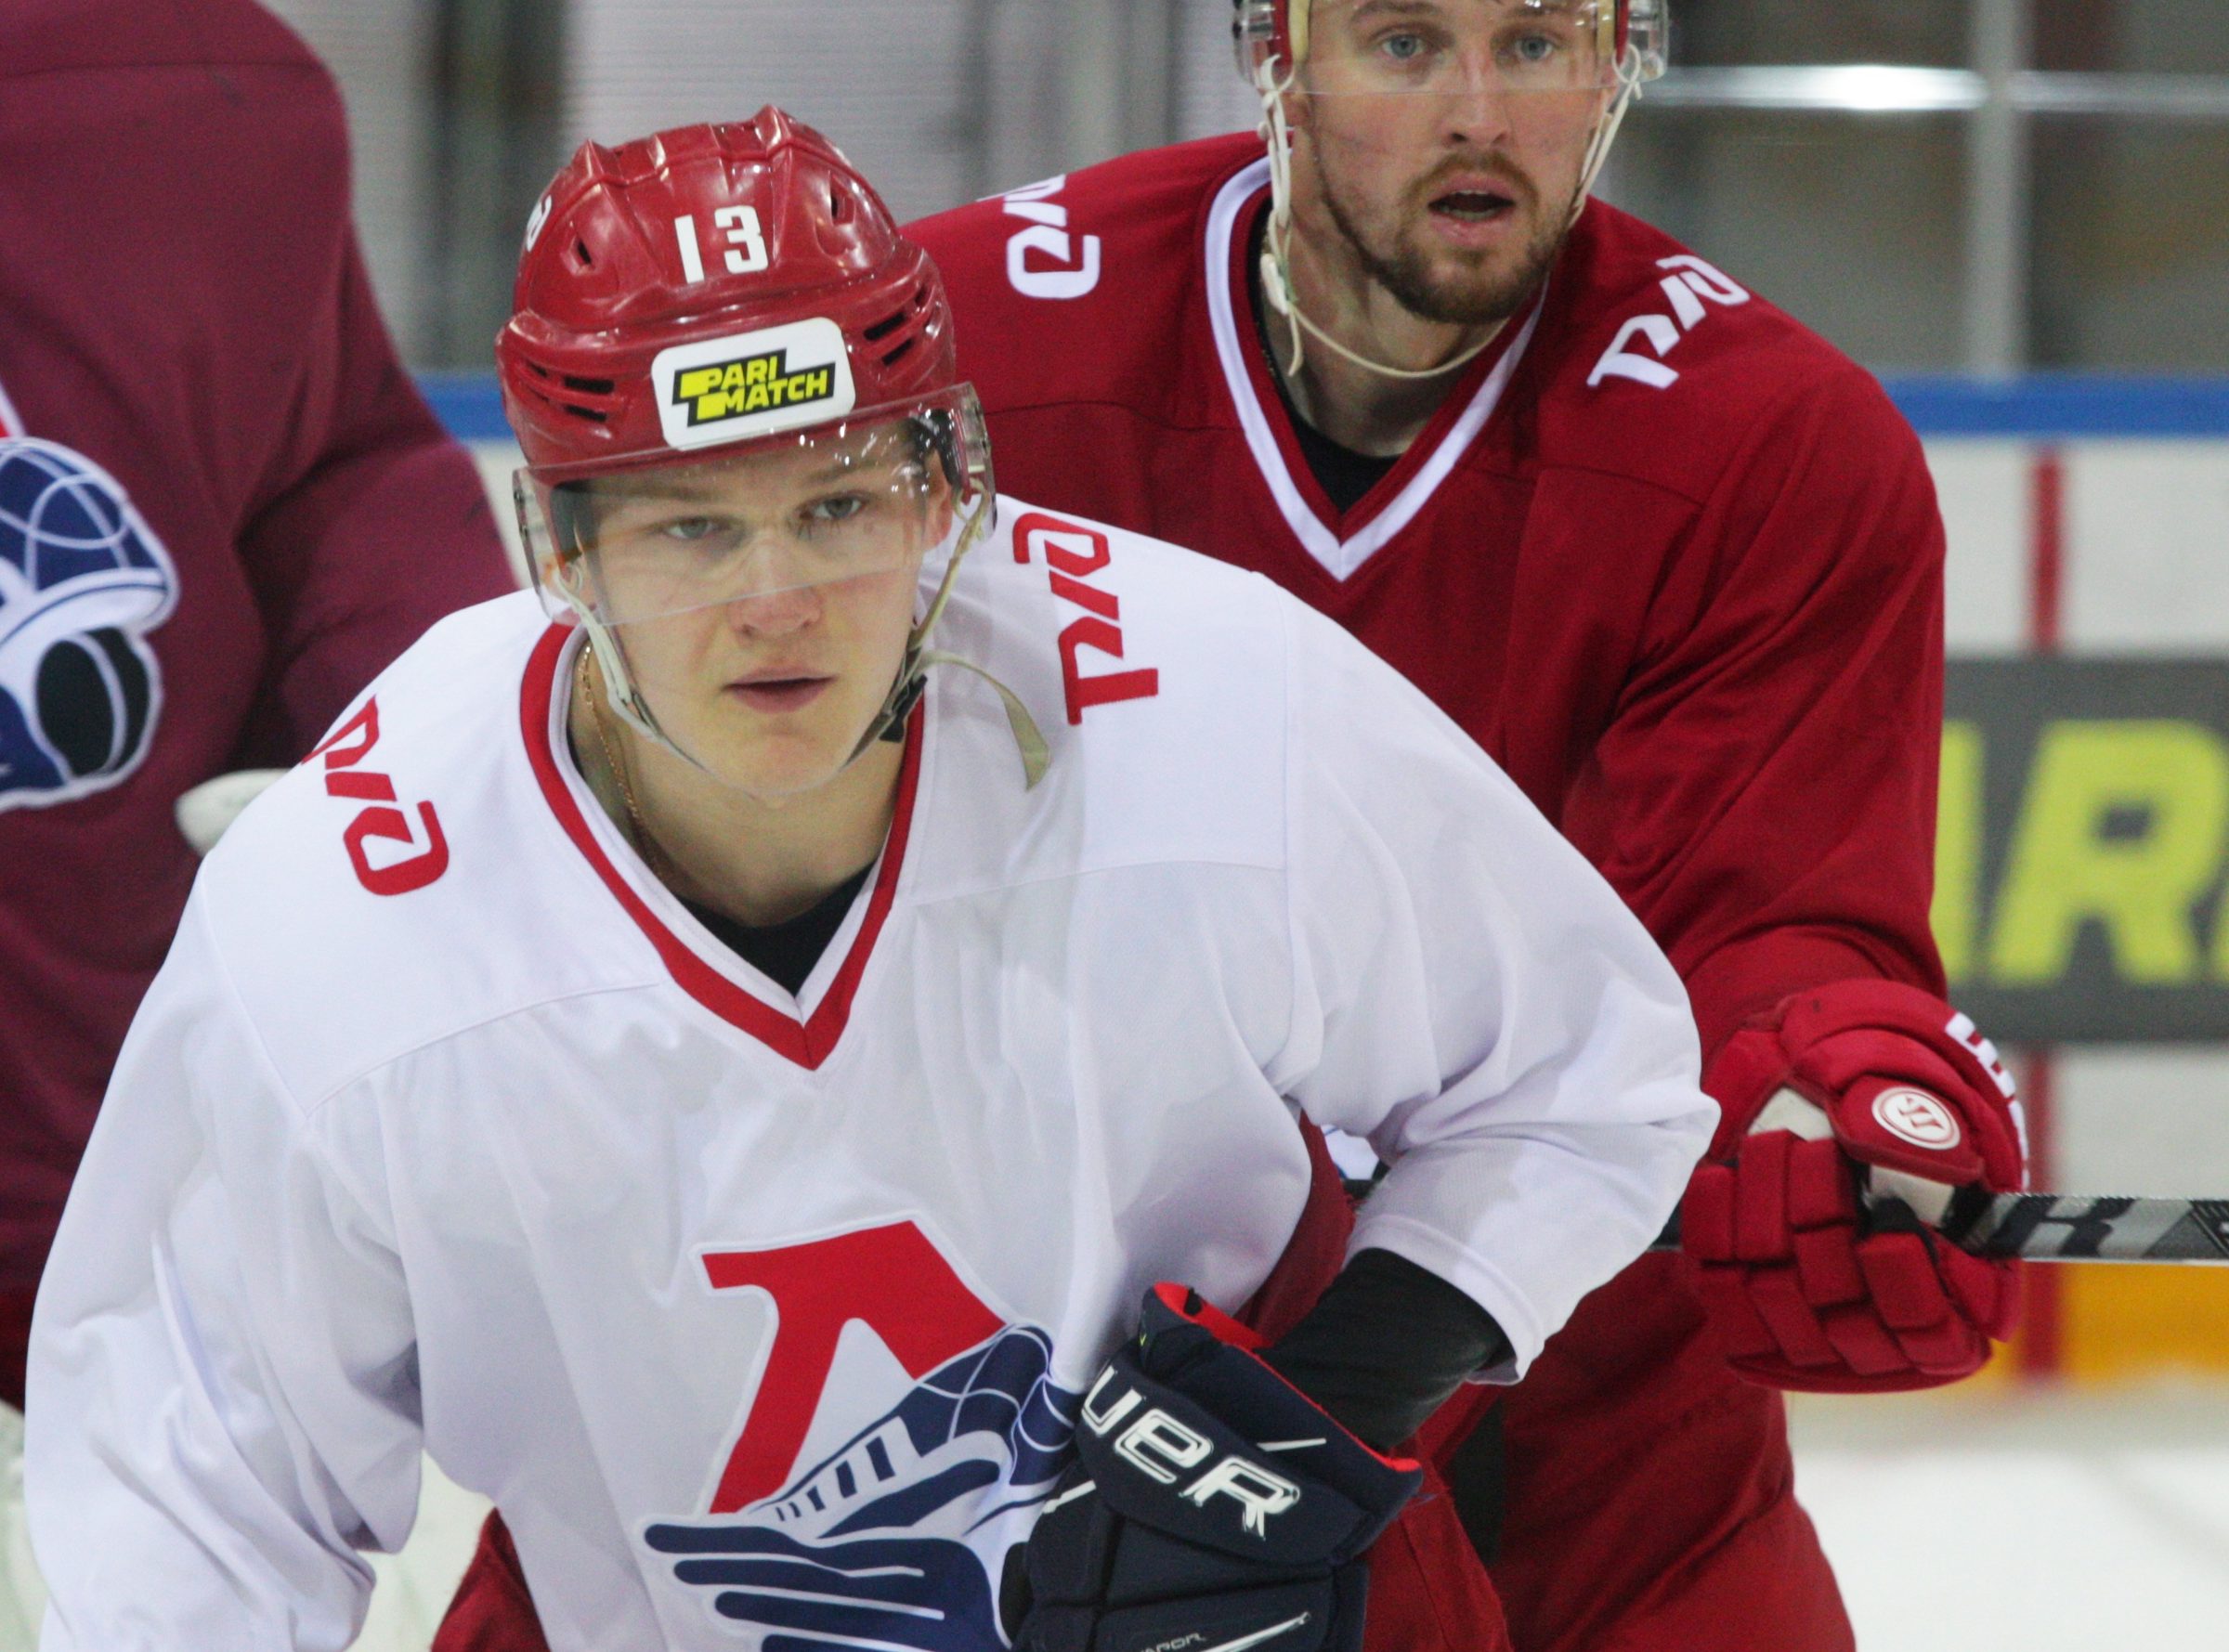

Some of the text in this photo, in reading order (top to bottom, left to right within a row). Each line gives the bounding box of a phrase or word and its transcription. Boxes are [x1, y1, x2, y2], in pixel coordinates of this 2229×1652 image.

[674, 205, 769, 284] 13
[679, 356, 778, 399] PARI
[697, 370, 828, 421] MATCH
